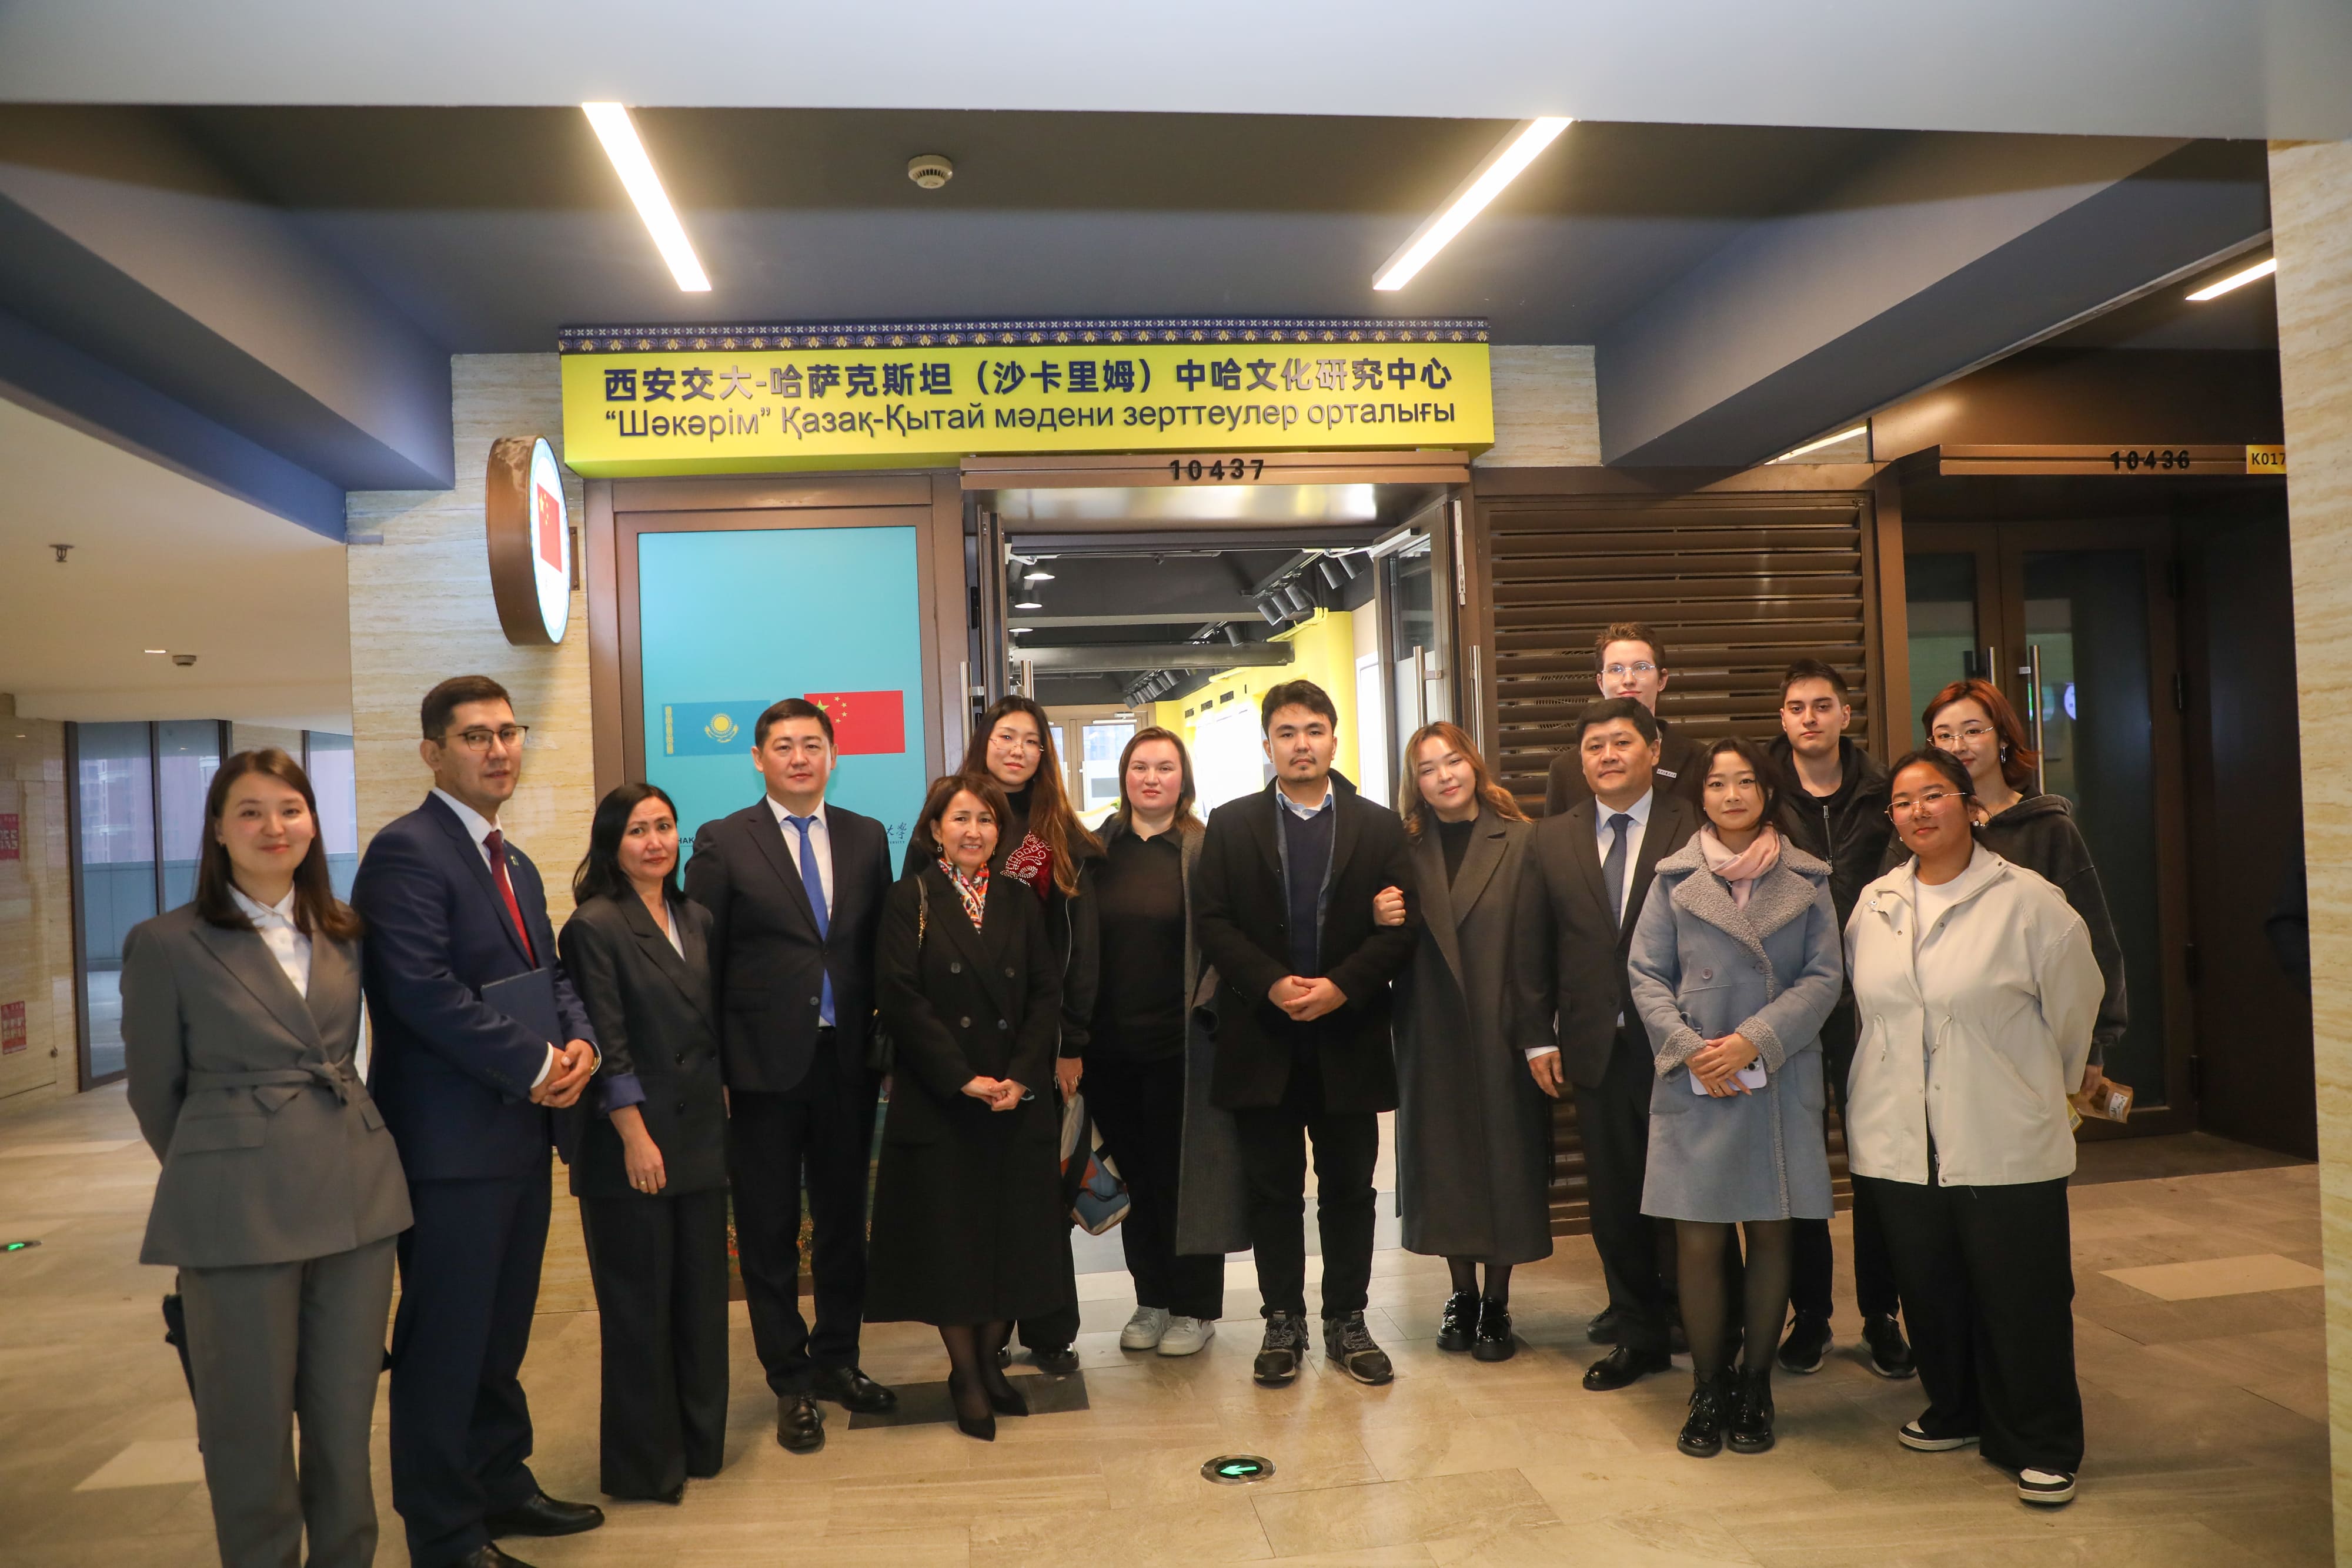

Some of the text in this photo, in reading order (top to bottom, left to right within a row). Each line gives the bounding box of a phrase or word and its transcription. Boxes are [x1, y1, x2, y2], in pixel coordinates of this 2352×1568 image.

[781, 402, 984, 440] Қазақ-Қытай
[995, 406, 1113, 432] мәдени
[1123, 404, 1299, 432] зерттеулер
[1308, 403, 1455, 430] орталығы
[1170, 458, 1264, 480] 10437
[2110, 450, 2190, 470] 10436
